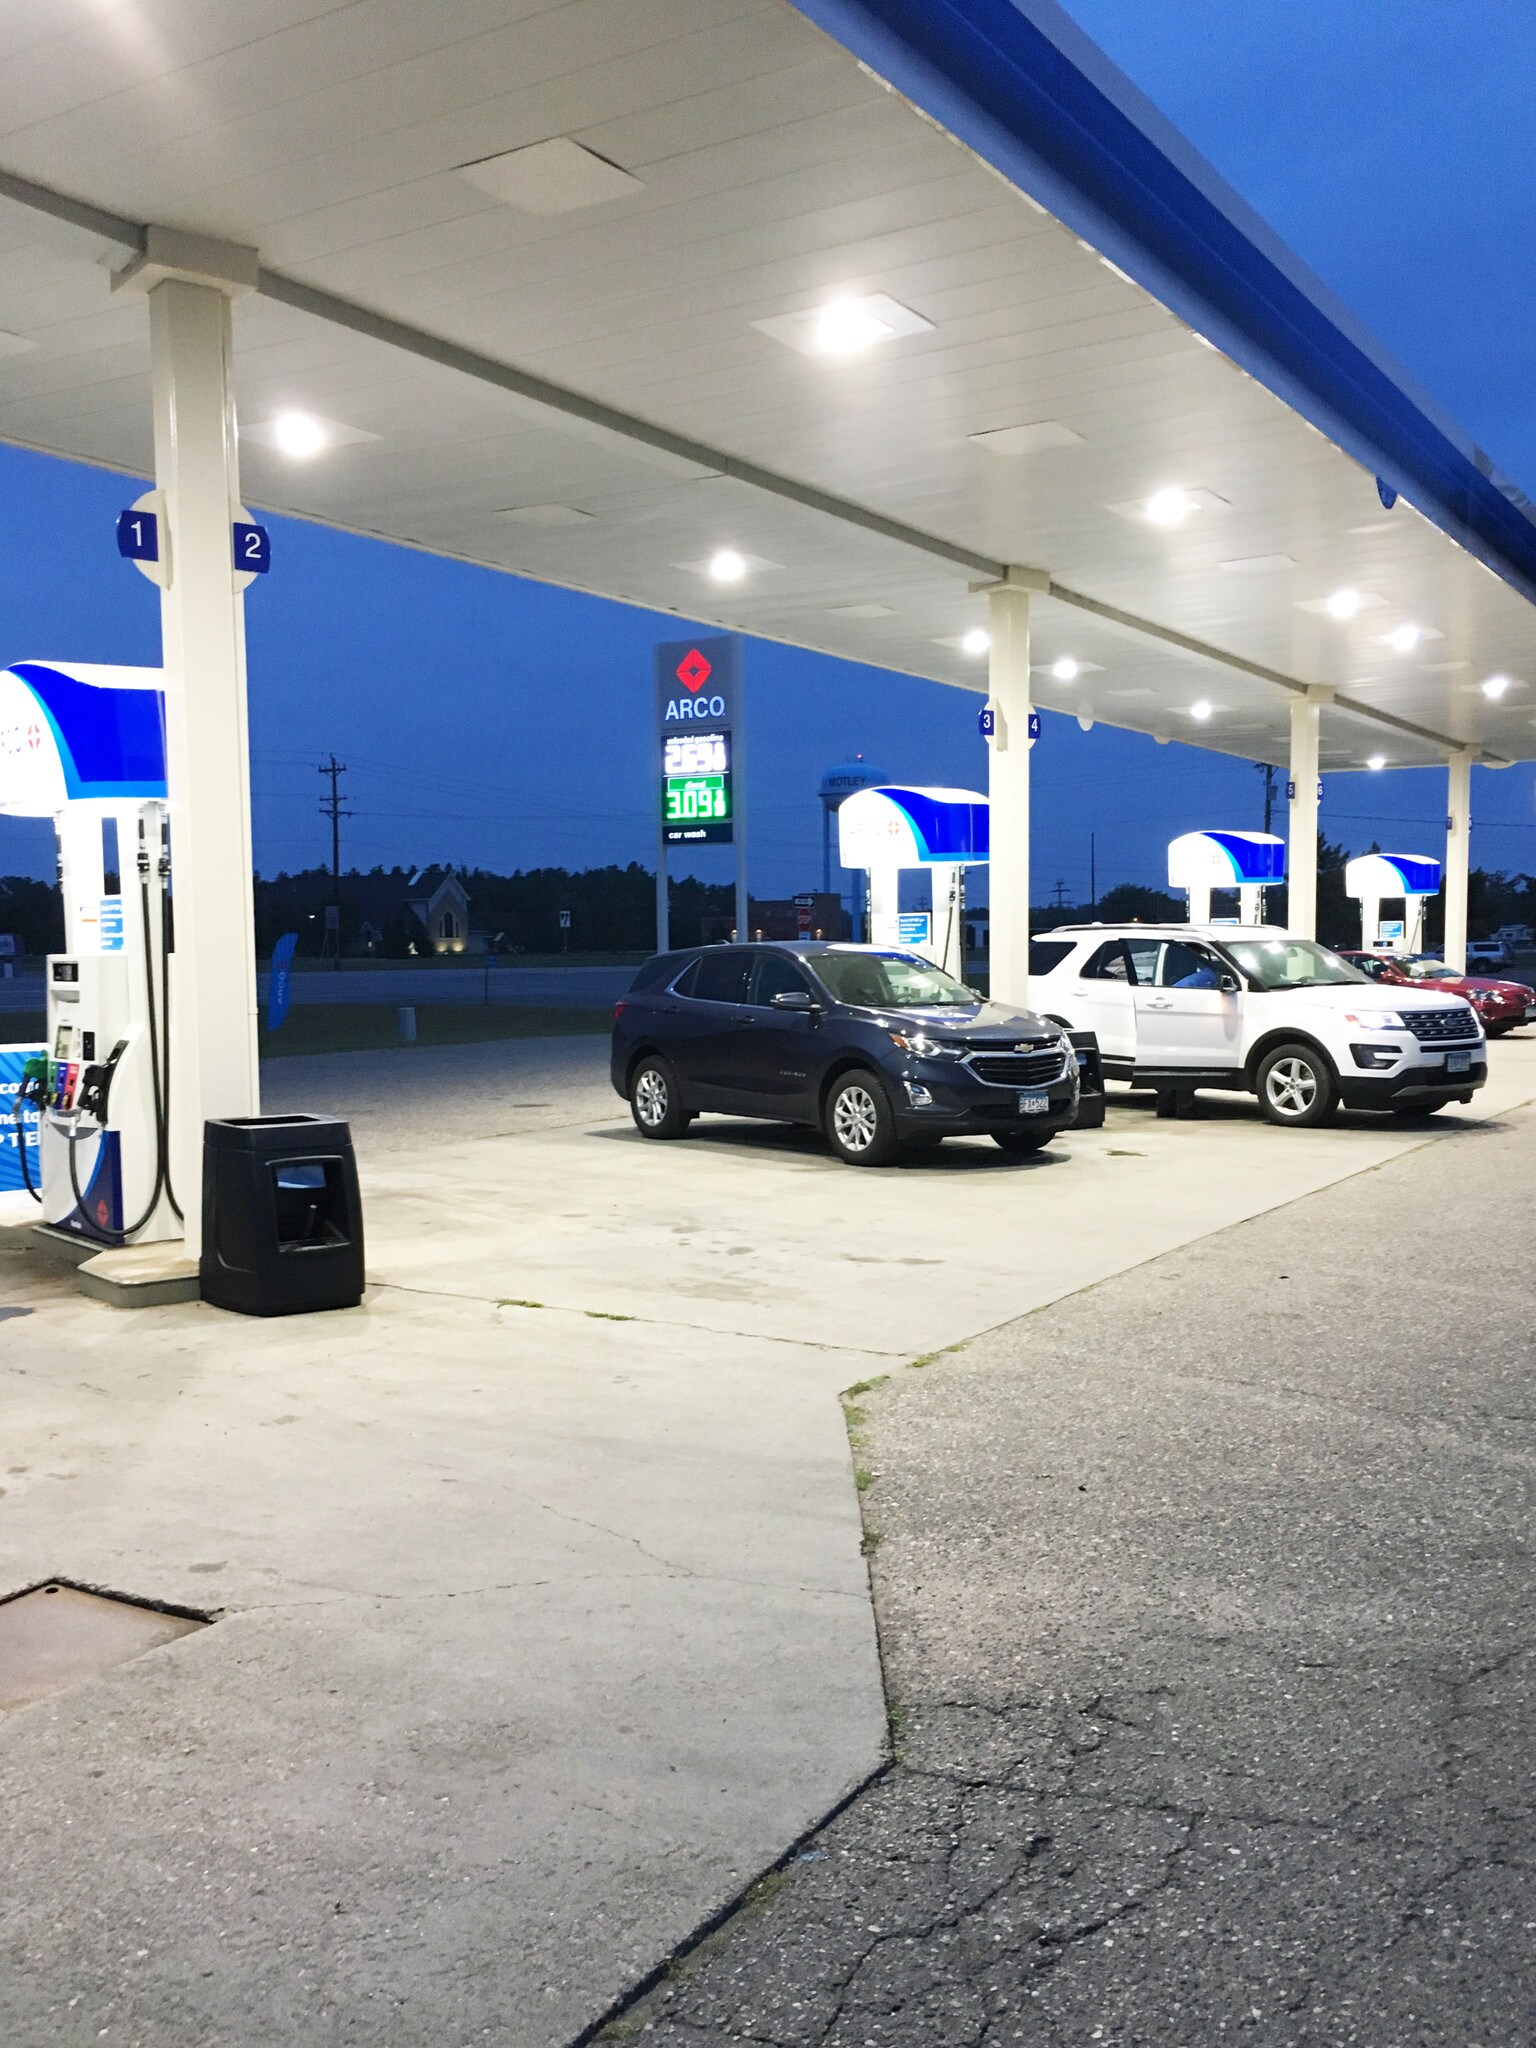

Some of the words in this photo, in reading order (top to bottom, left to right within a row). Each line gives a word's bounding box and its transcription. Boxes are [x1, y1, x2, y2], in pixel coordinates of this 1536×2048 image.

[131, 521, 142, 546] 1
[245, 533, 261, 559] 2
[665, 696, 725, 720] ARCO
[983, 714, 991, 728] 3
[1031, 718, 1038, 732] 4
[829, 776, 866, 786] MOTLEY
[1288, 784, 1293, 795] 5
[1318, 785, 1323, 796] 6
[684, 829, 706, 838] wash
[277, 971, 286, 1004] ARCO
